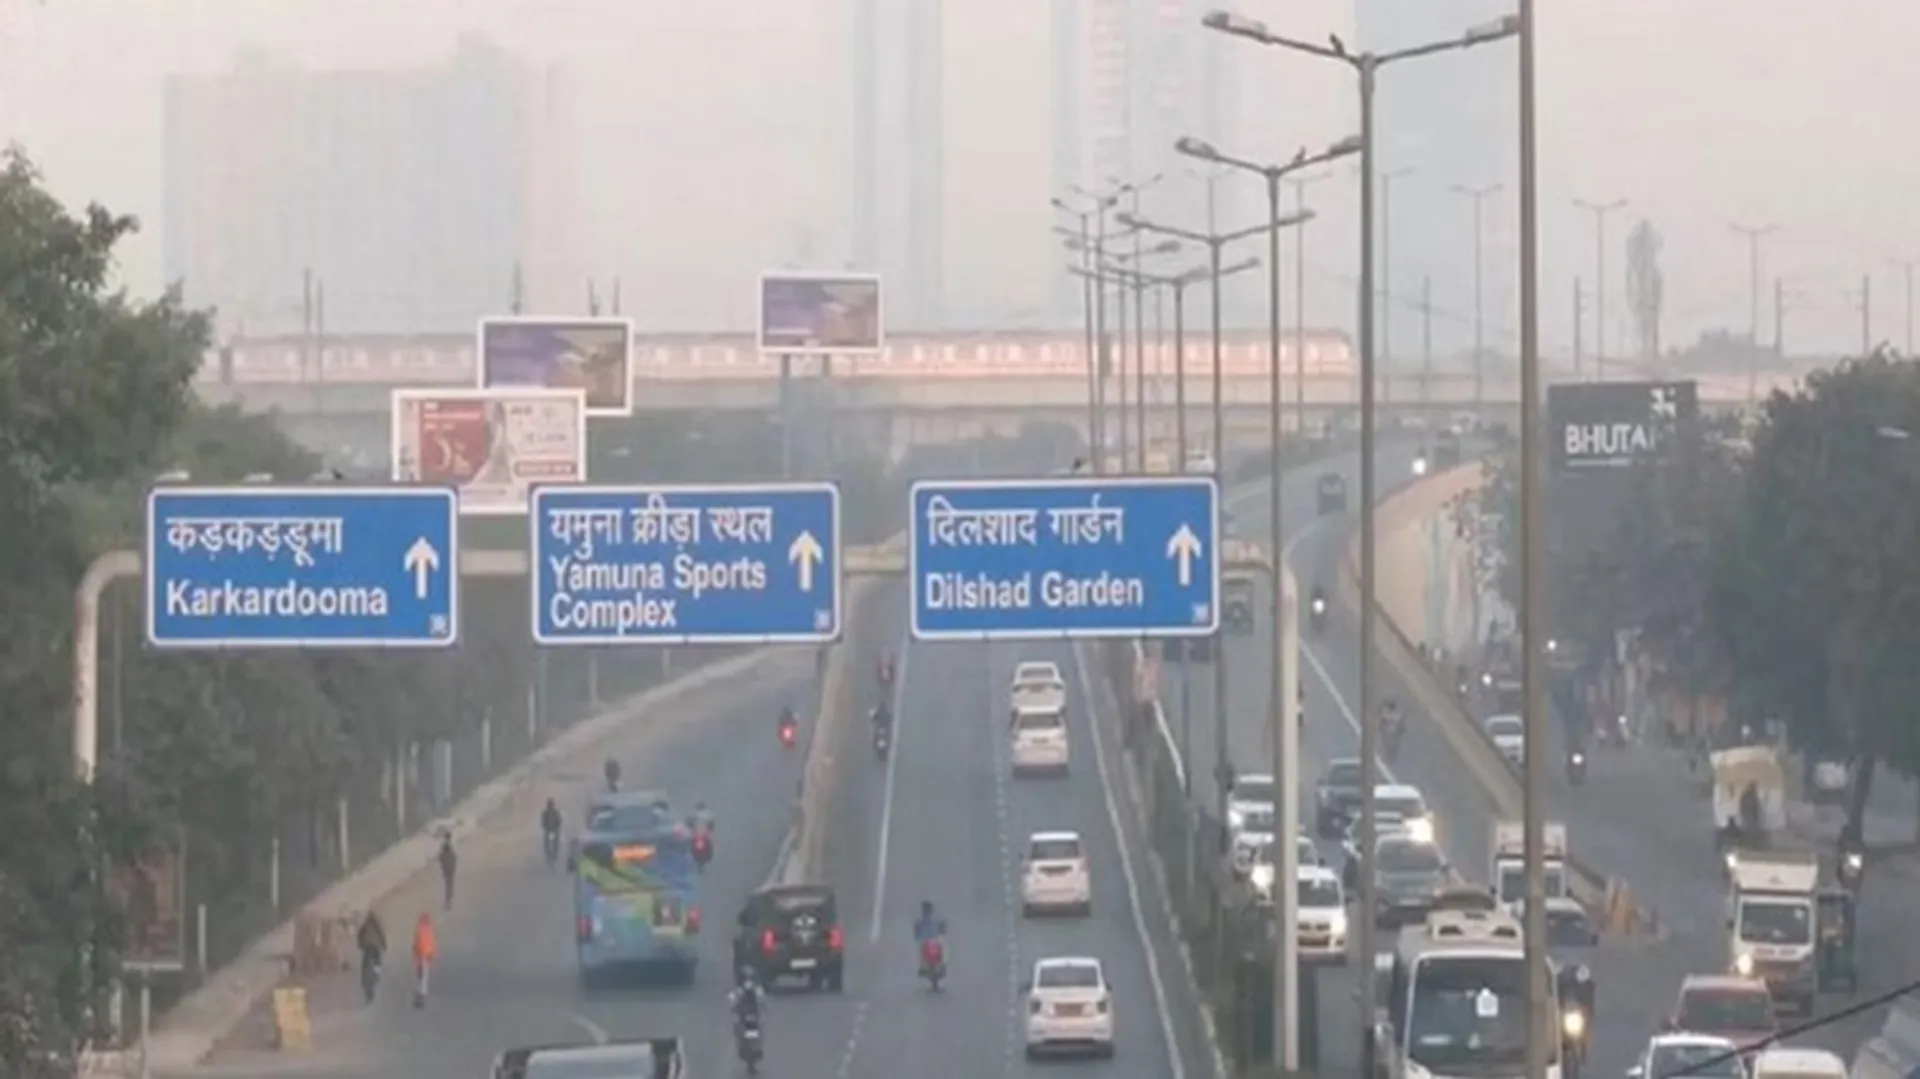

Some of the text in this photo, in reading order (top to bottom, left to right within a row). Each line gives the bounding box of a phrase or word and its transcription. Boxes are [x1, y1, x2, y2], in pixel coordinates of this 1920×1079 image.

[165, 516, 344, 567] कड़कड़डूमा
[548, 493, 772, 560] यमुना क्रीड़ा स्थल
[926, 493, 1124, 545] दिलशाद गार्डन
[165, 578, 389, 617] Karkardooma
[549, 553, 767, 599] Yamuna Sports
[926, 571, 1144, 609] Dilshad Garden
[551, 592, 677, 636] Complex
